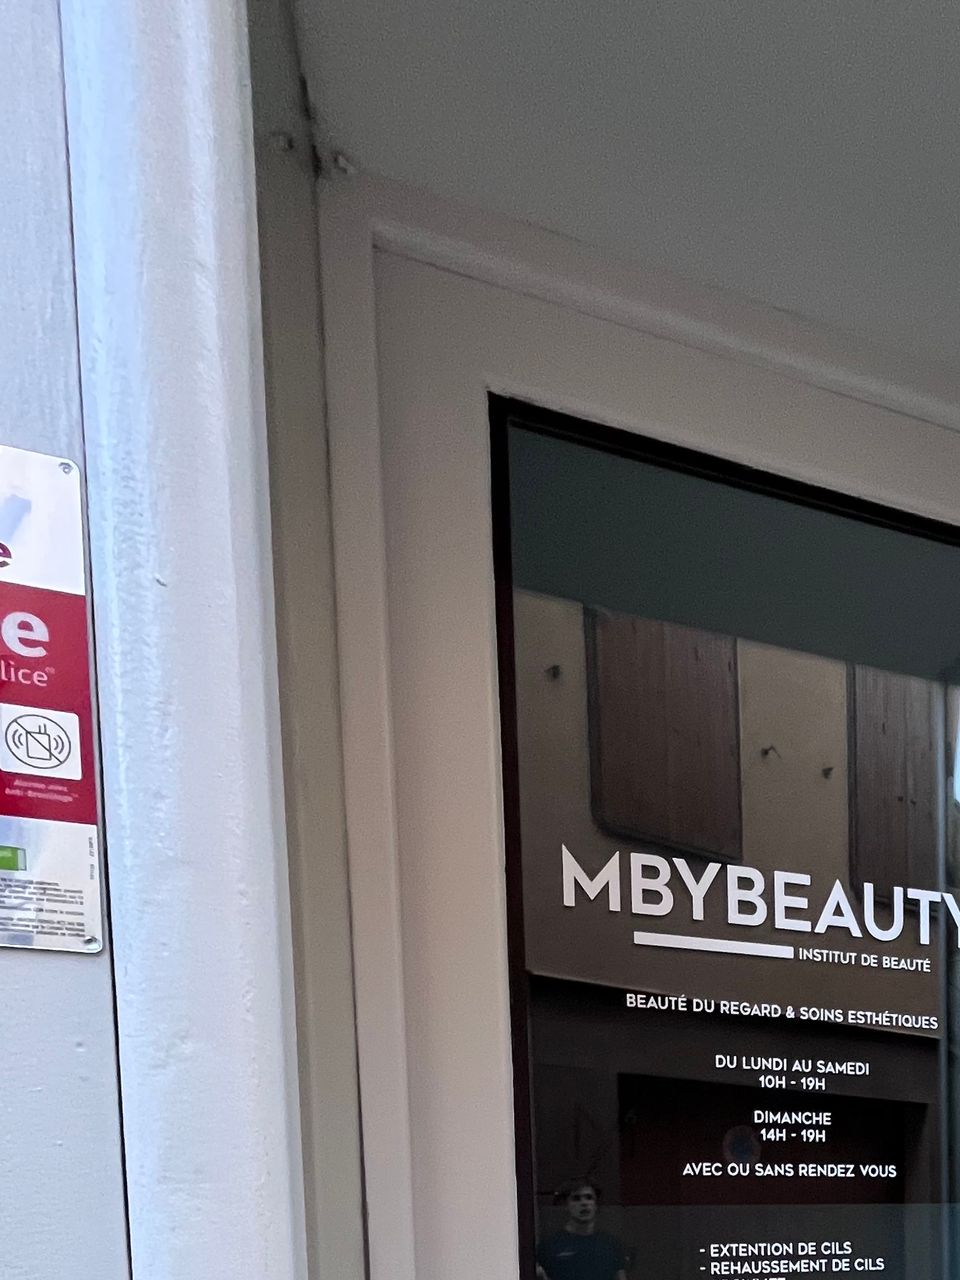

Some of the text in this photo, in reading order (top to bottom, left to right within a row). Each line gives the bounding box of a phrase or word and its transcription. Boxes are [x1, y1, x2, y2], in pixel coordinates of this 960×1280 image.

[799, 948, 931, 972] INSTITUT DE BEAUTÉ
[626, 994, 938, 1029] BEAUTÉ DU REGARD & SOINS ESTHÉTIQUES
[715, 1055, 869, 1075] DU LUNDI AU SAMEDI
[759, 1075, 786, 1088] 10H
[801, 1077, 825, 1090] 19H
[754, 1110, 832, 1125] DIMANCHE
[760, 1128, 786, 1141] 14H
[801, 1129, 825, 1142] 19H
[683, 1162, 897, 1177] AVEC OU SANS RENDEZ VOUS
[710, 1243, 793, 1257] EXTENTION
[798, 1242, 816, 1255] DE
[821, 1241, 852, 1255] CILS
[711, 1259, 828, 1275] REHAUSSEMENT
[832, 1259, 850, 1271] DE
[854, 1258, 884, 1271] CILS
